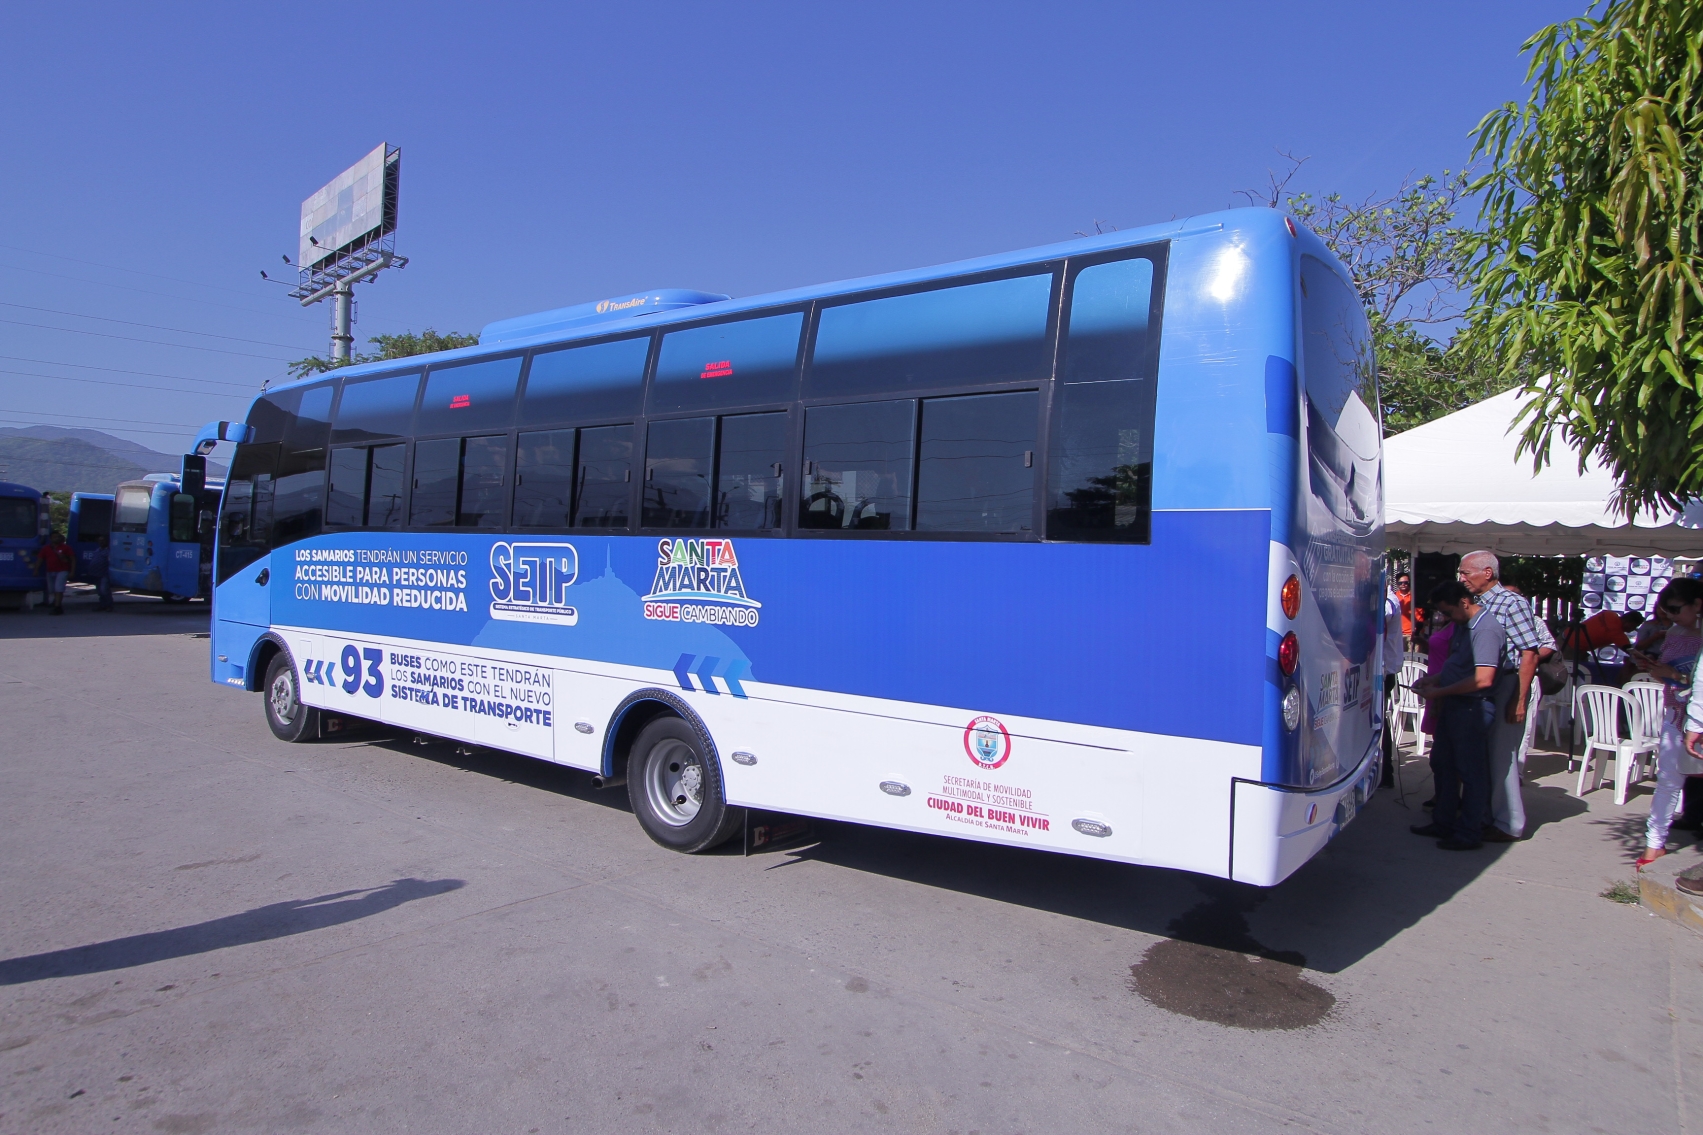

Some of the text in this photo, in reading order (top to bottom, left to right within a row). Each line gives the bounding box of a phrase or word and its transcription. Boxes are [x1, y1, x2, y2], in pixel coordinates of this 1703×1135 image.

[705, 360, 730, 371] SALIDA
[295, 547, 468, 566] LOS SAMARIOS TENDRÁN UN SERVICIO
[658, 538, 739, 567] SANTA
[1324, 545, 1355, 564] GRATUITAS
[295, 564, 467, 589] ACCESIBLE PARA PERSONAS
[490, 541, 579, 606] SETP
[651, 565, 747, 598] MARTA
[295, 583, 468, 612] CON MOVILIDAD REDUCIDA
[645, 602, 760, 626] SIGUE CAMBIANDO
[341, 644, 384, 699] 93
[390, 652, 551, 688] BUSES COMO ESTE TENDRÁN
[1319, 670, 1338, 692] SANTA
[390, 668, 551, 706] LOS SAMARIOS CON EL NUEVO
[1343, 665, 1360, 705] SETP
[391, 684, 552, 727] SISTEMA DE TRANSPORTE
[1316, 688, 1339, 712] MARTA
[974, 716, 987, 725] SANTA
[942, 786, 1033, 811] MULTIMODAL Y SOSTENIBLE
[943, 775, 1032, 799] SECRETARÍA DE MOVILIDAD
[927, 797, 1050, 832] CIUDAD DEL BUEN VIVIR
